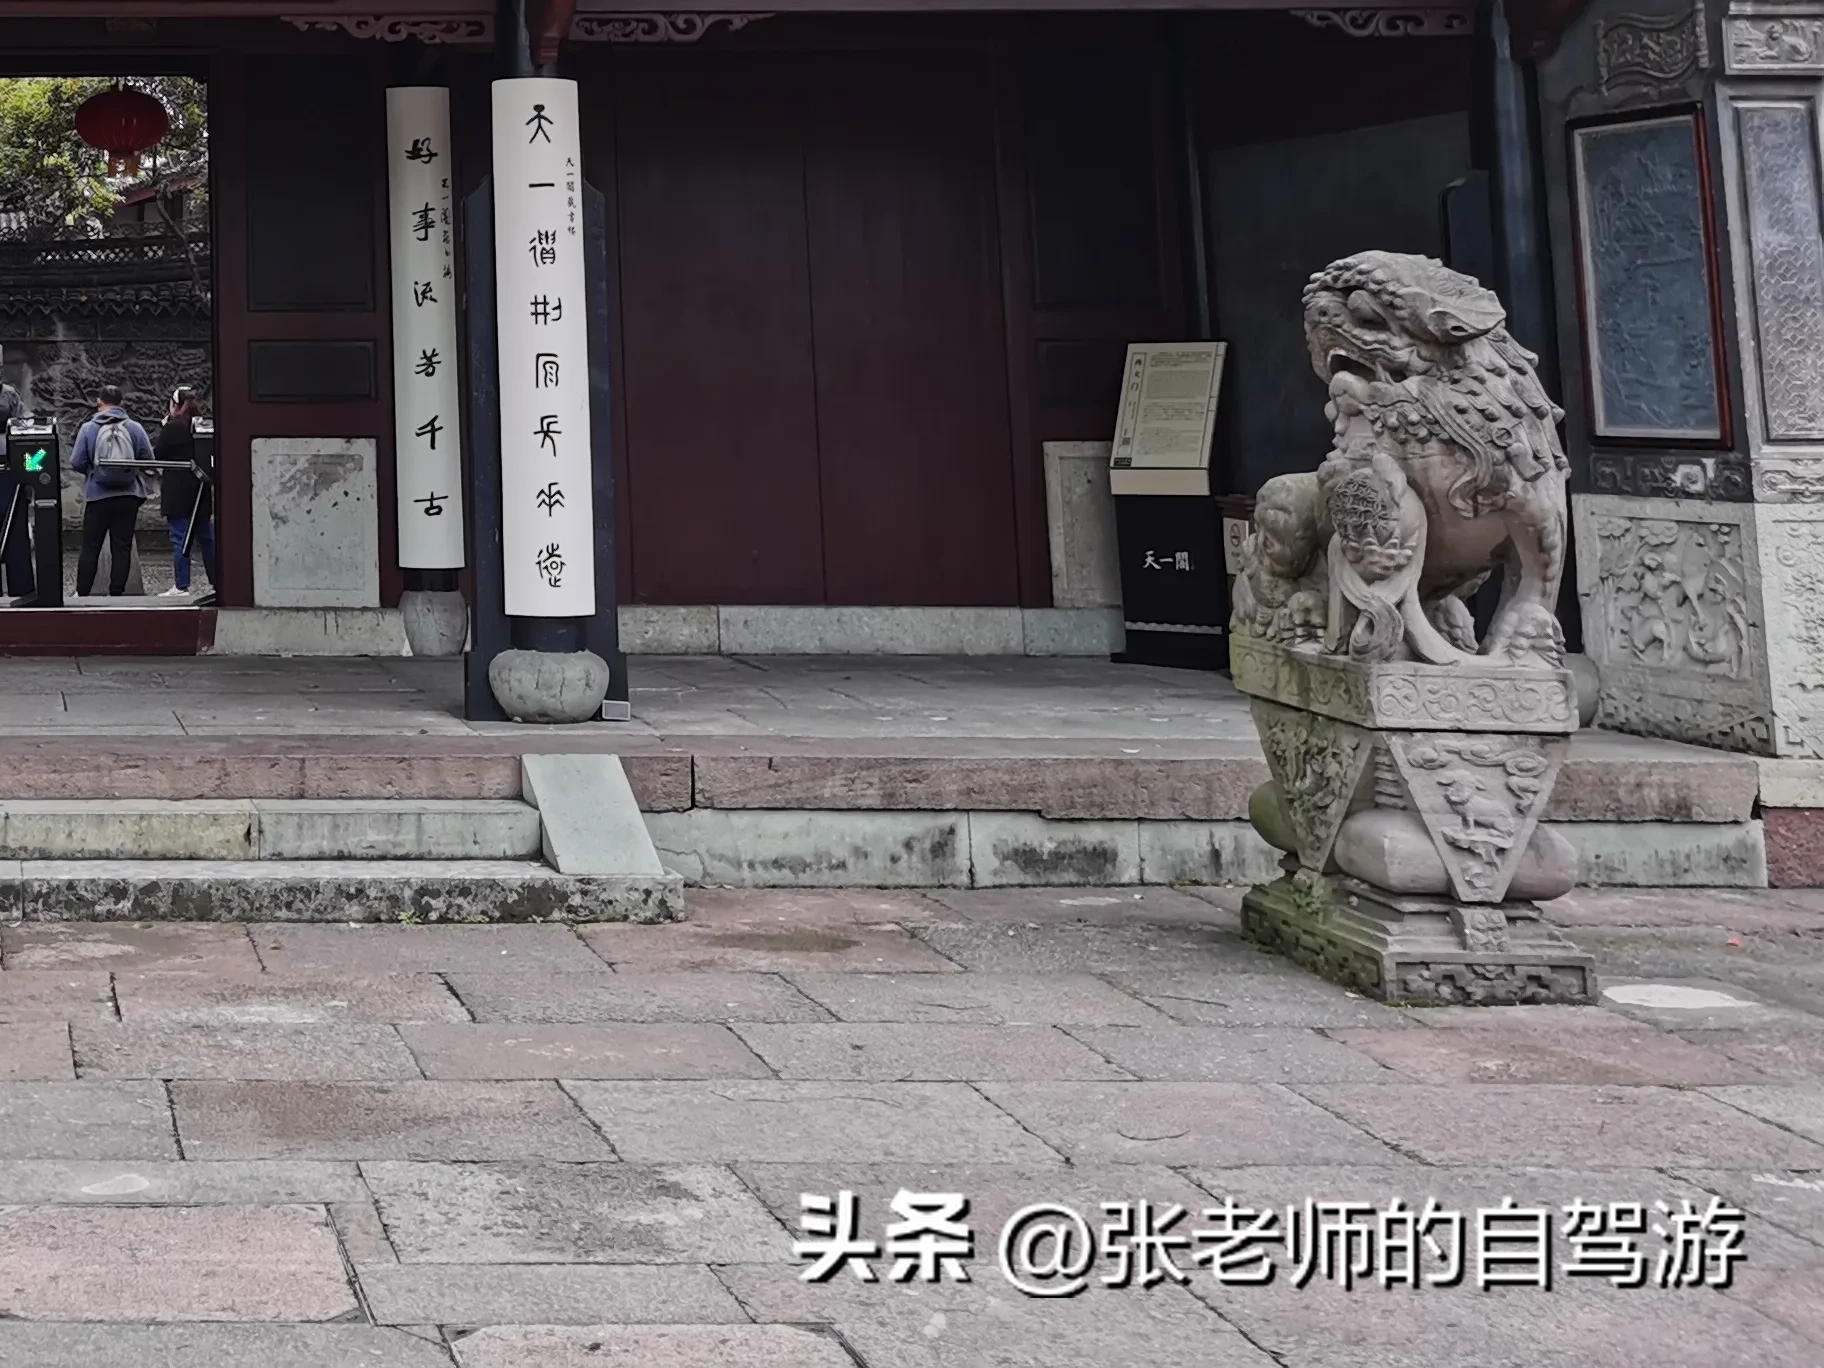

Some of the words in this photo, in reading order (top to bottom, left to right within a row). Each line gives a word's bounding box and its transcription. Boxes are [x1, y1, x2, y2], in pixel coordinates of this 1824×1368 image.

[405, 137, 450, 518] 好事流芳千古
[1143, 550, 1190, 572] 天一閣
